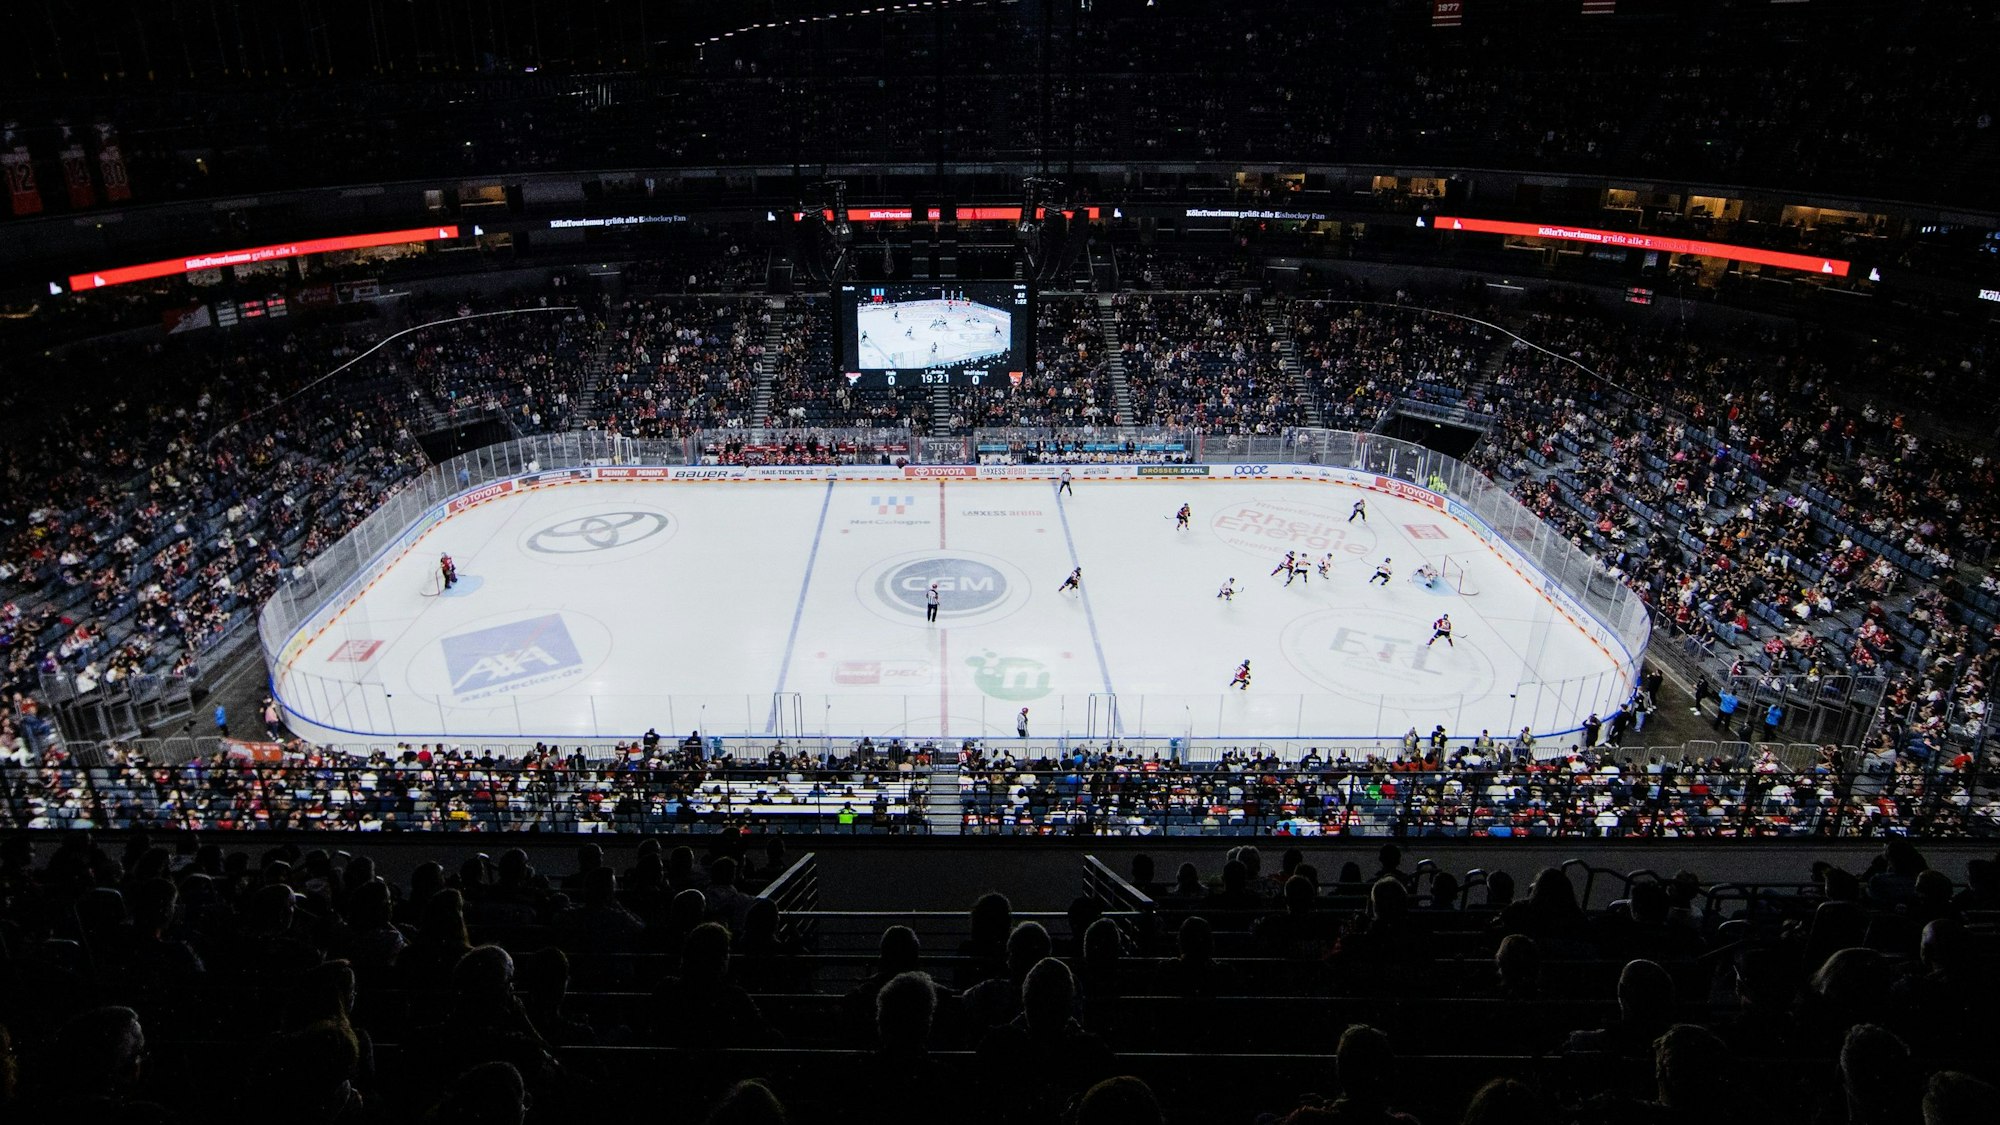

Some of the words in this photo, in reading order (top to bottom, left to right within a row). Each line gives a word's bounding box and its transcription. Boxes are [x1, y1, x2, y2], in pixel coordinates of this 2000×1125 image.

[1437, 3, 1460, 12] 1977
[550, 218, 604, 228] KölnTourismus
[605, 217, 624, 226] grüßt
[625, 216, 638, 224] alle
[639, 215, 672, 223] Eishockey
[1186, 209, 1239, 218] KölnTourismus
[1240, 211, 1259, 219] grüßt
[1274, 211, 1310, 220] Eishockey
[1538, 227, 1601, 241] KölnTourismus
[1602, 234, 1626, 244] grüßt
[1627, 237, 1643, 245] alle
[887, 375, 896, 385] 0
[921, 374, 949, 383] 19:21
[971, 375, 980, 385] 0
[930, 468, 966, 476] TOYOTA
[981, 467, 1006, 476] LANXESS
[1234, 465, 1269, 476] pape
[470, 485, 503, 502] TOYOTA
[1401, 485, 1436, 504] TOYOTA
[850, 518, 930, 526] NetCologne
[1237, 508, 1347, 540] Rhein
[1214, 515, 1370, 555] Energie
[902, 576, 994, 591] CGM
[1330, 627, 1442, 676] ETL
[453, 645, 560, 690] AXA
[1002, 665, 1055, 689] m
[460, 667, 583, 703] axa-decker.de
